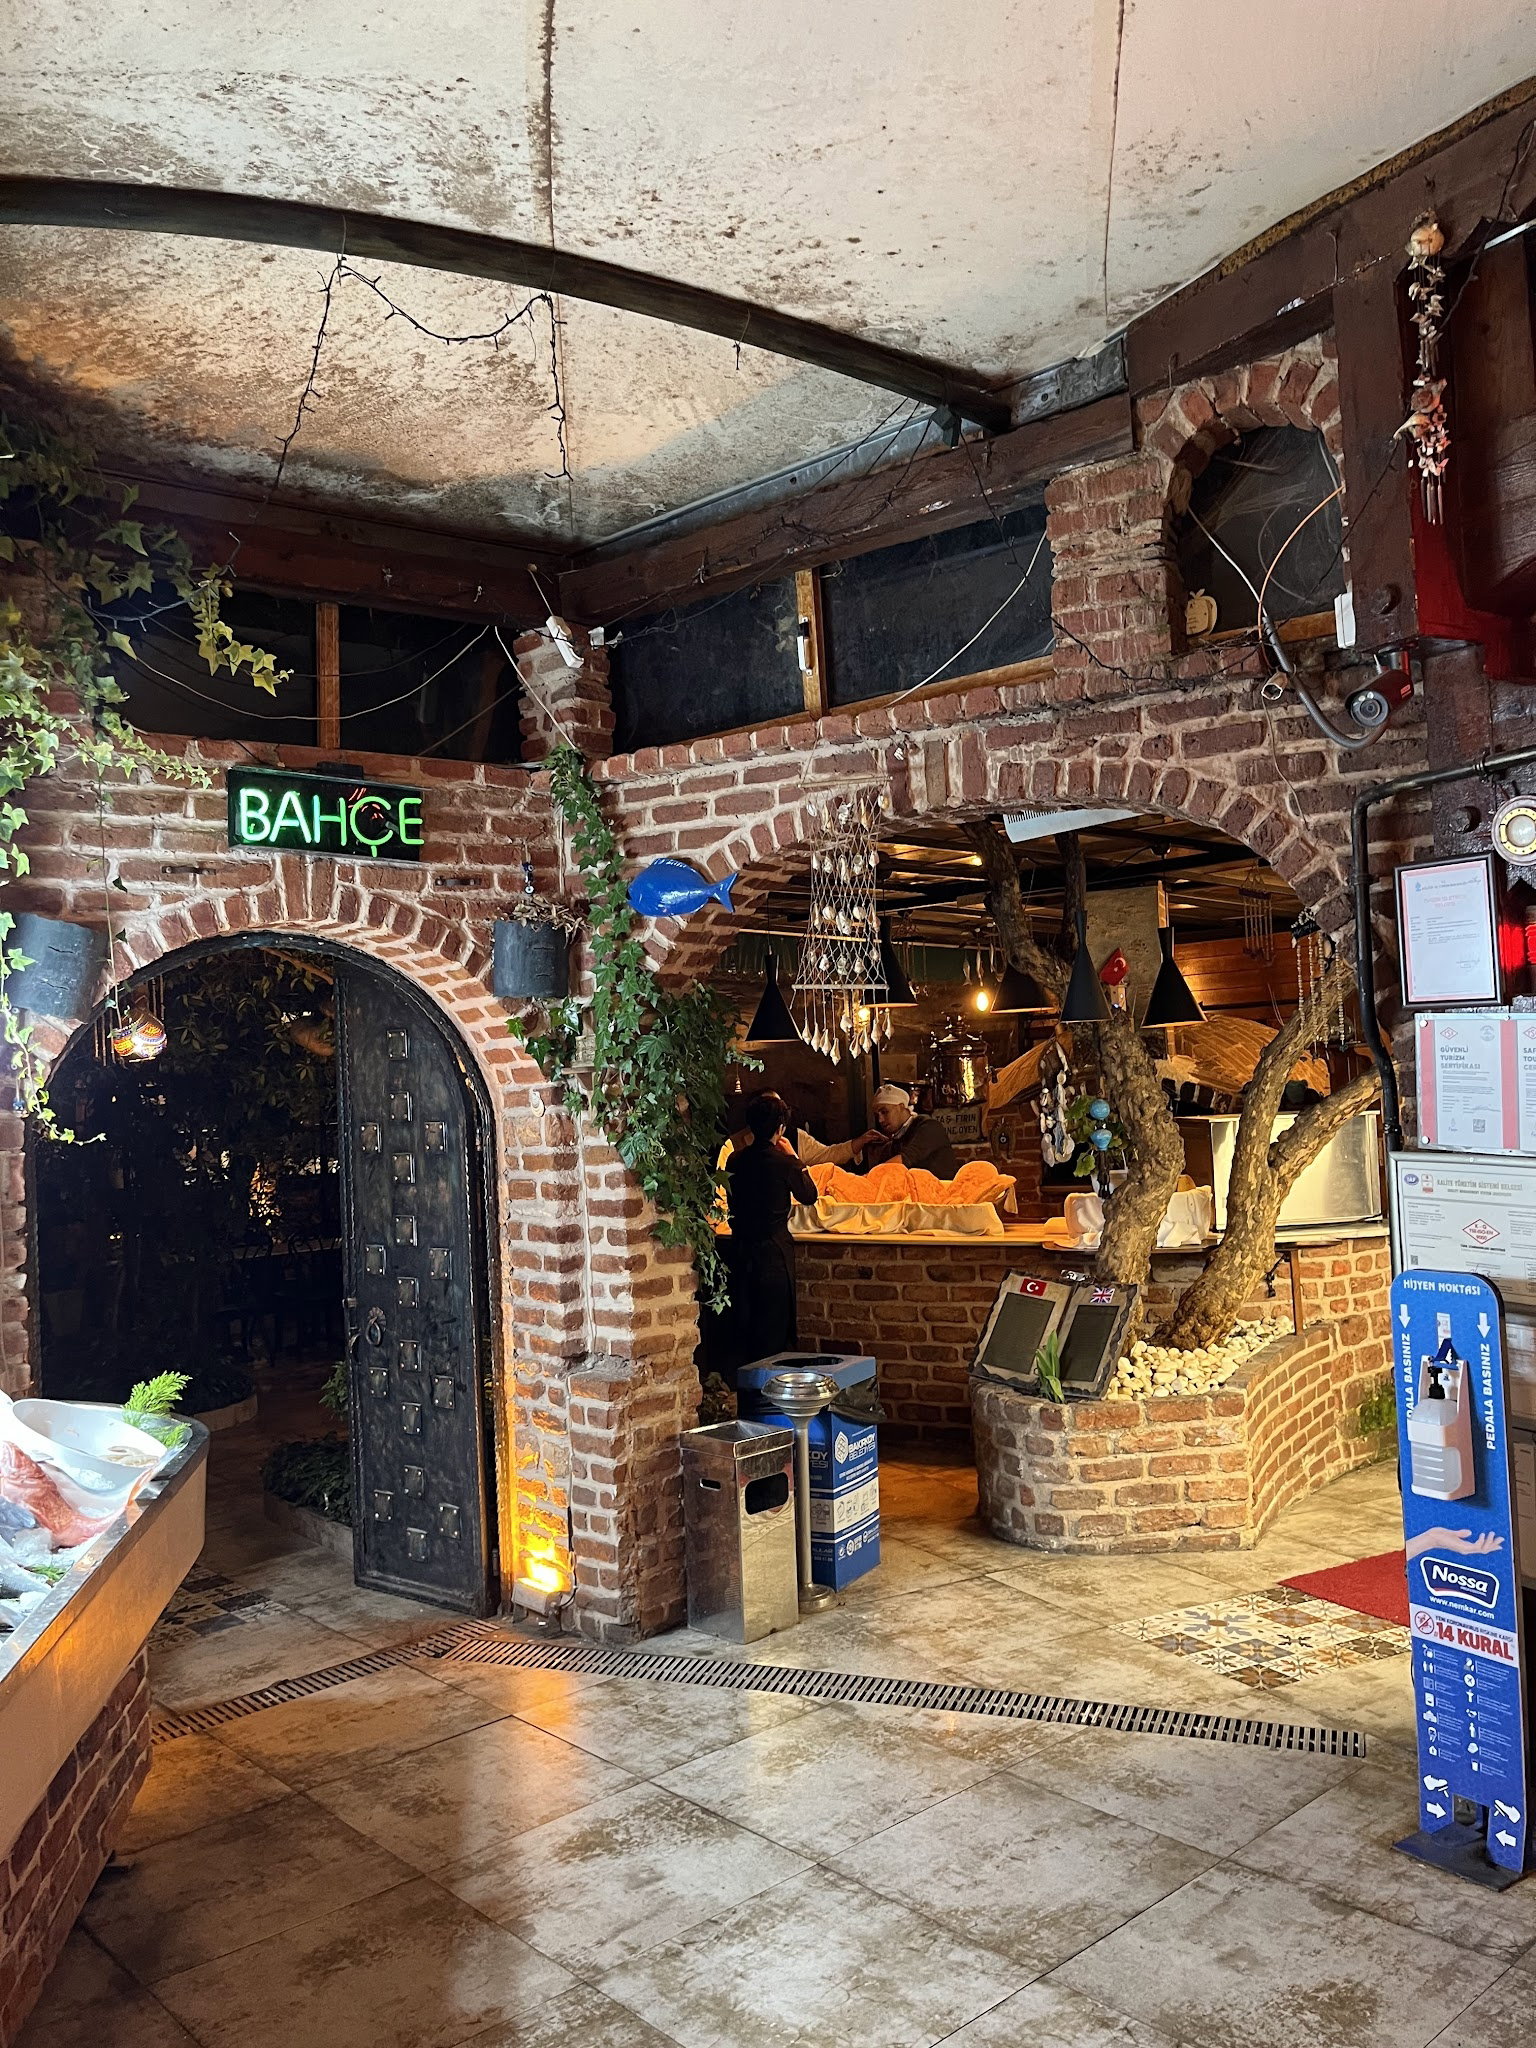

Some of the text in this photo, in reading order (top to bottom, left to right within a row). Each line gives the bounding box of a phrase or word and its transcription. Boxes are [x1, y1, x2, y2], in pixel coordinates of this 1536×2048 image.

[239, 788, 425, 858] BAHÇE
[1403, 1278, 1481, 1295] HİJYEN NOKTASI
[1401, 1333, 1416, 1418] DALA BASINIZ
[1480, 1343, 1496, 1450] PEDALA BASINIZ
[1432, 1564, 1488, 1593] Nossa
[1428, 1595, 1495, 1620] www.nemkar.com
[1456, 1627, 1514, 1661] KURAL
